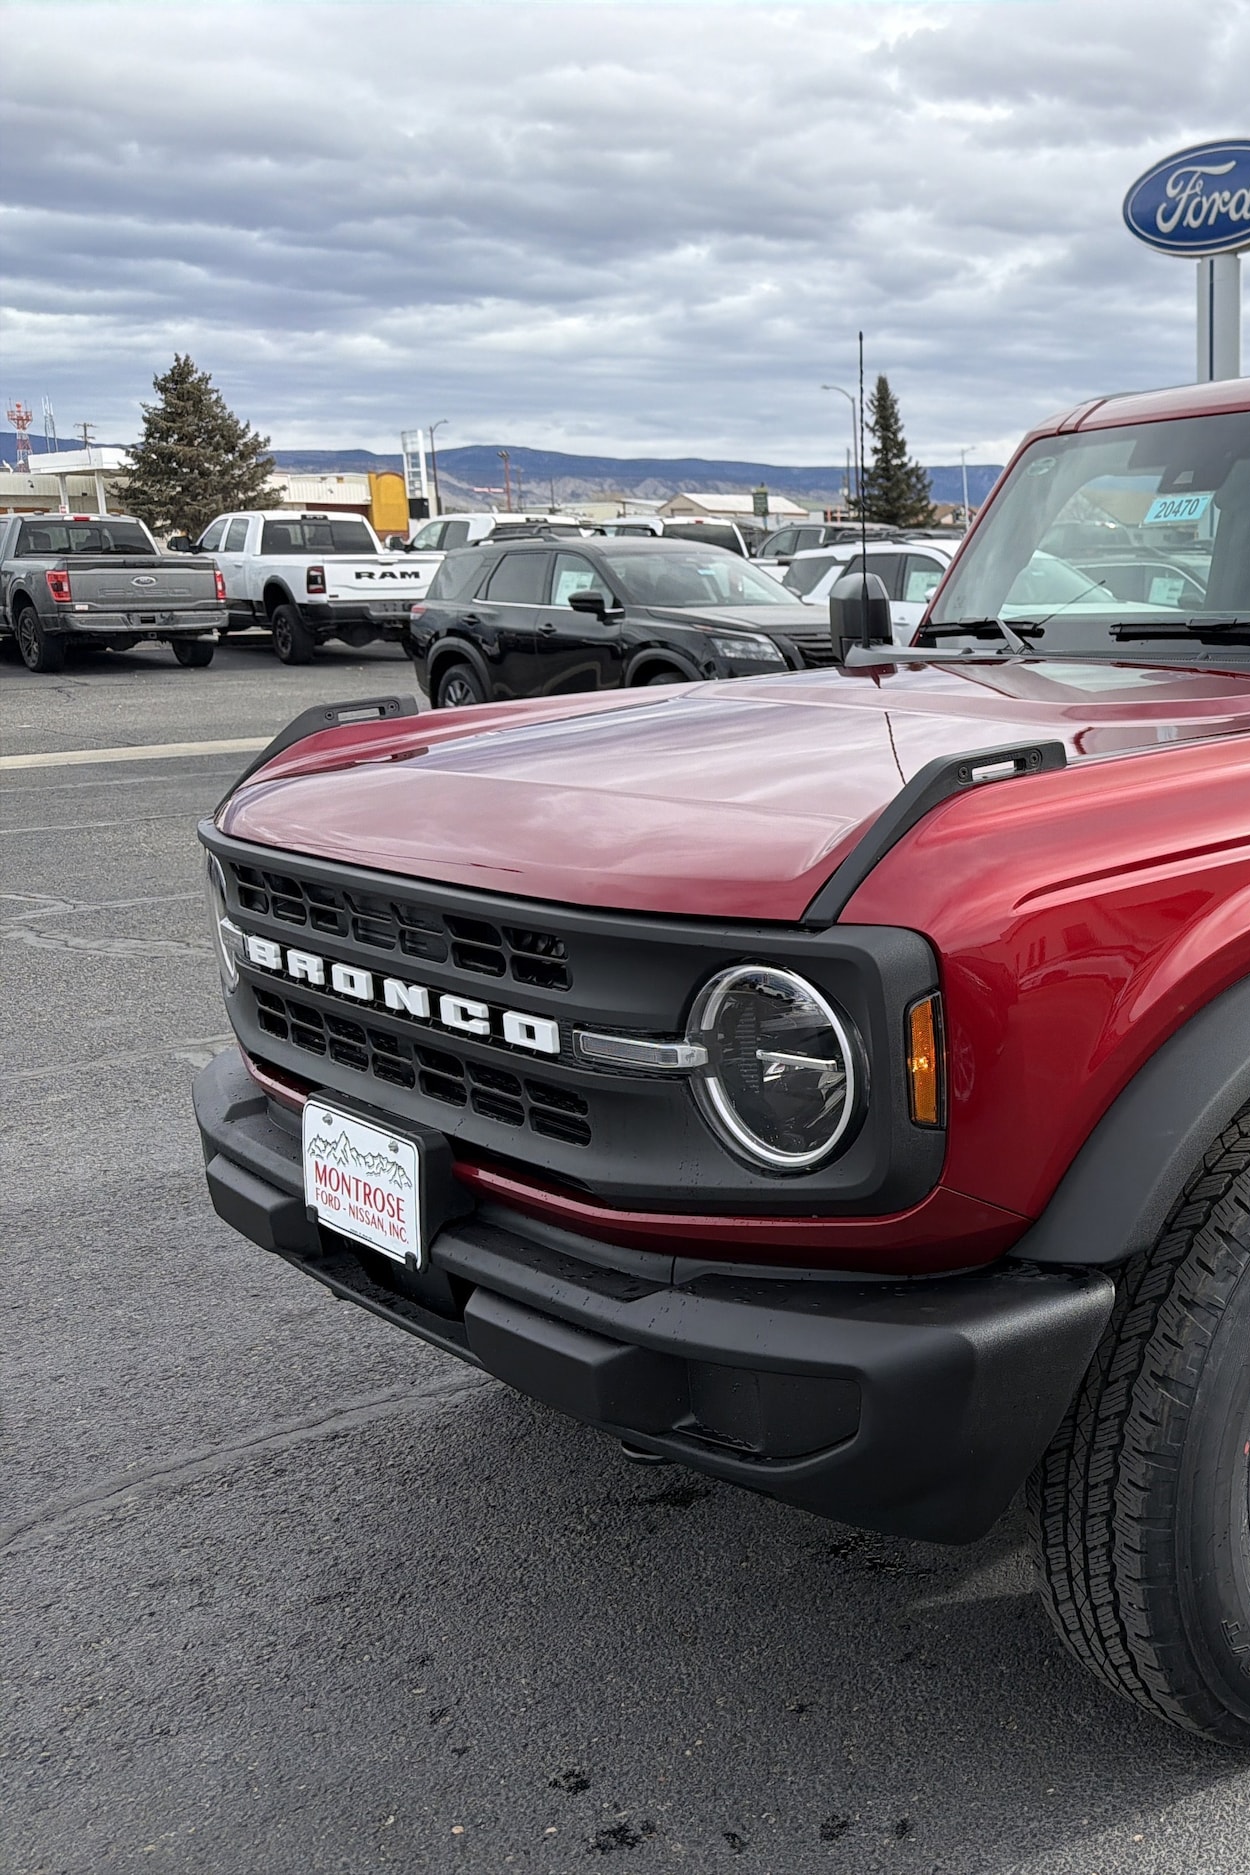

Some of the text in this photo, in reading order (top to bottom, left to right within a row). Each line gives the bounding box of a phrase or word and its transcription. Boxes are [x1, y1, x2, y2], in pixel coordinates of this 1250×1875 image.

[1154, 498, 1200, 519] 20470
[354, 571, 420, 580] RAM
[249, 935, 560, 1054] BRONCO
[314, 1160, 406, 1224] MONTROSE
[315, 1187, 341, 1211] FORD
[348, 1202, 387, 1236] NISSAN,
[389, 1221, 409, 1244] INC.
